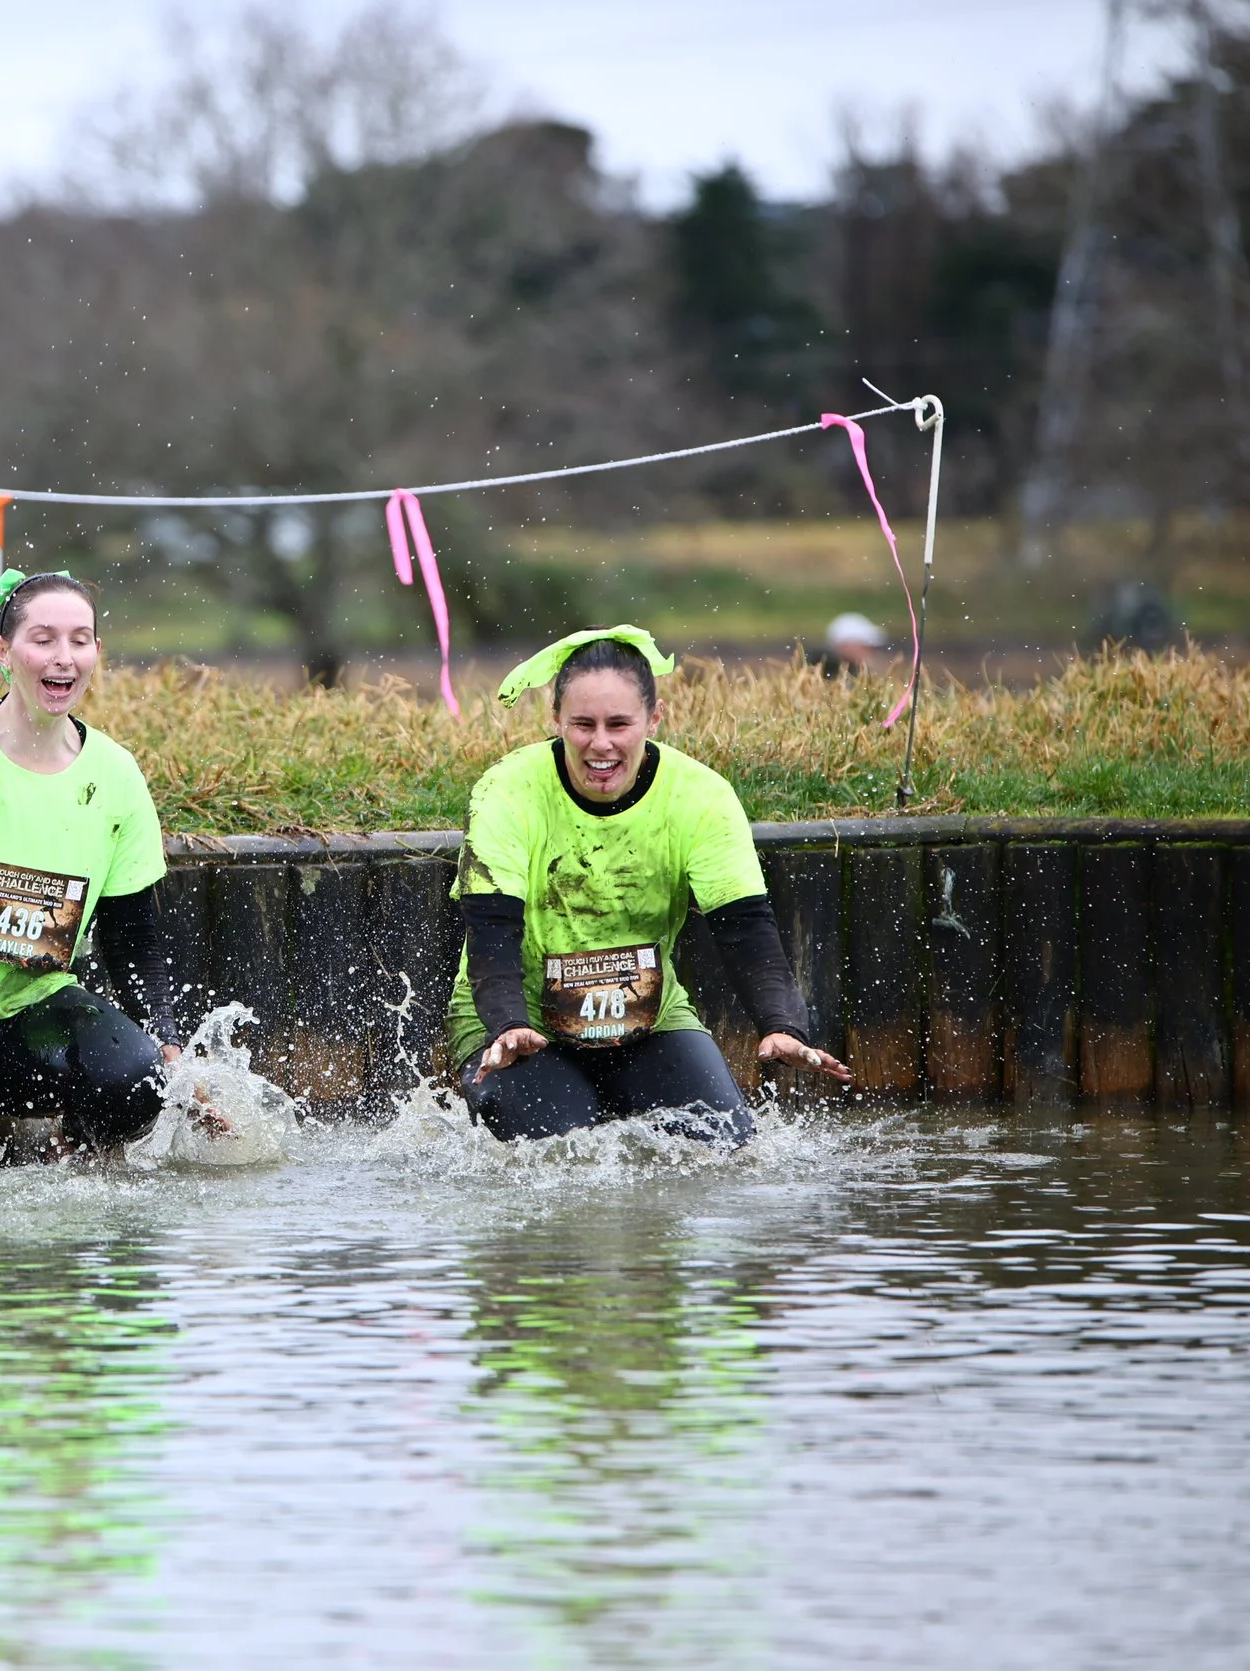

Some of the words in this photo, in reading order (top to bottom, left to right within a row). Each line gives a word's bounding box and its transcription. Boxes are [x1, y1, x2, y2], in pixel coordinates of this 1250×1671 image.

[21, 873, 36, 882] GUY
[36, 876, 51, 884] AND
[51, 878, 65, 886] GAL
[603, 953, 619, 961] AND
[620, 951, 635, 959] GAL
[564, 959, 636, 977] CHALLENGE
[580, 989, 625, 1022] 478
[581, 1023, 625, 1039] JORDAN
